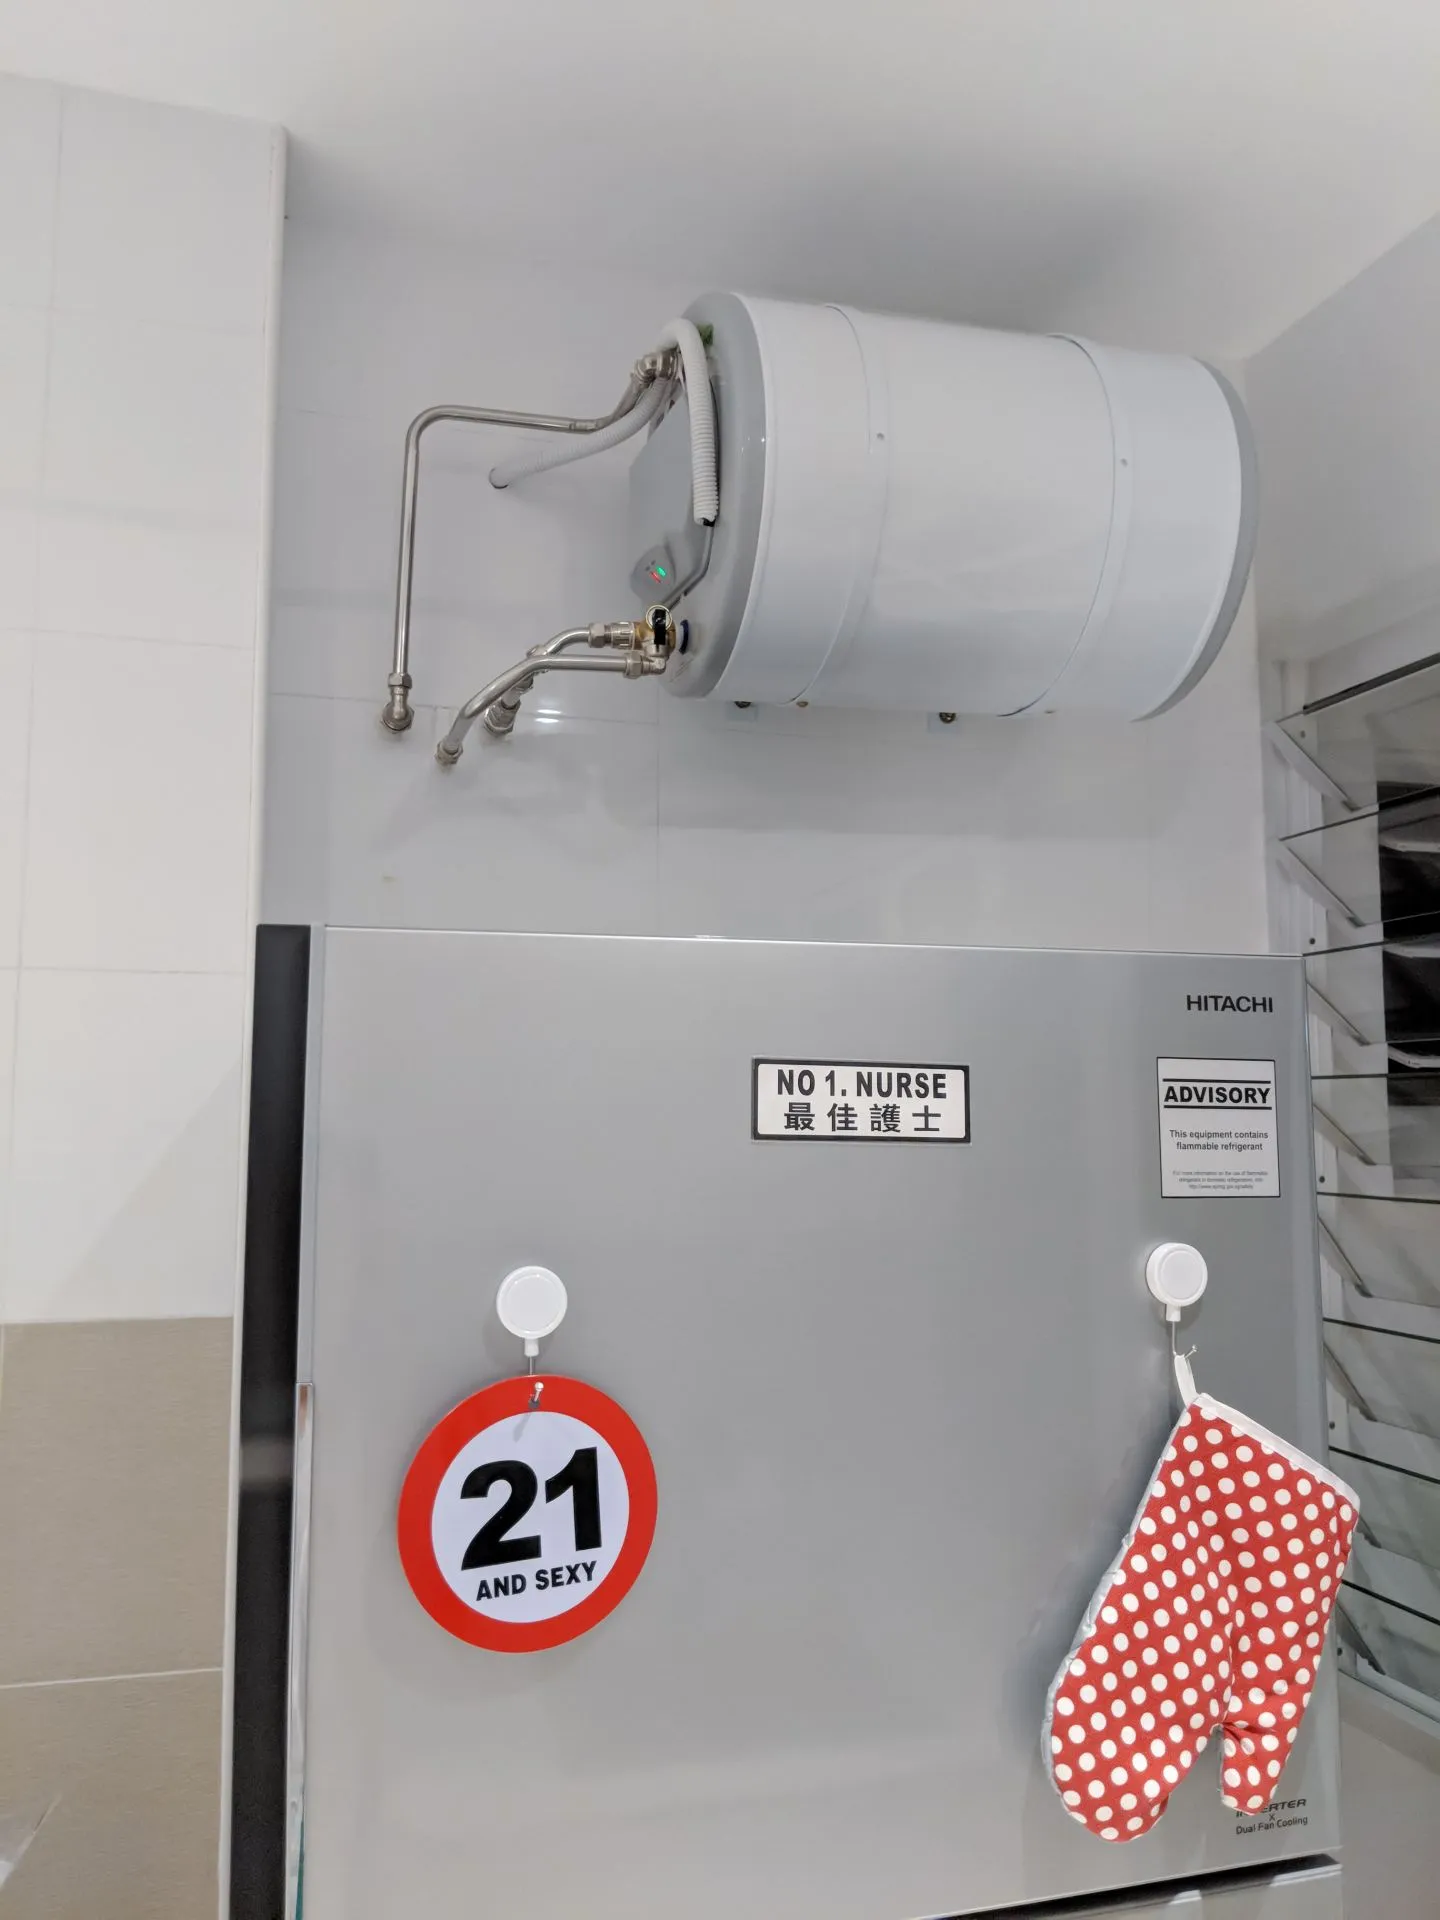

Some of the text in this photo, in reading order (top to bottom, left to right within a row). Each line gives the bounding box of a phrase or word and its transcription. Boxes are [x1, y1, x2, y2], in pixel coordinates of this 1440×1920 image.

[1186, 994, 1273, 1013] HITACHI
[777, 1069, 947, 1099] NO 1. NURSE
[1164, 1085, 1271, 1104] ADVISORY
[784, 1102, 942, 1133] 最佳護士
[1169, 1129, 1268, 1141] This equipment contains
[1176, 1141, 1263, 1153] flammable refrigerant
[460, 1446, 602, 1571] 21
[476, 1560, 597, 1601] AND SEXY
[1235, 1816, 1308, 1834] Dual Fan Cooling
